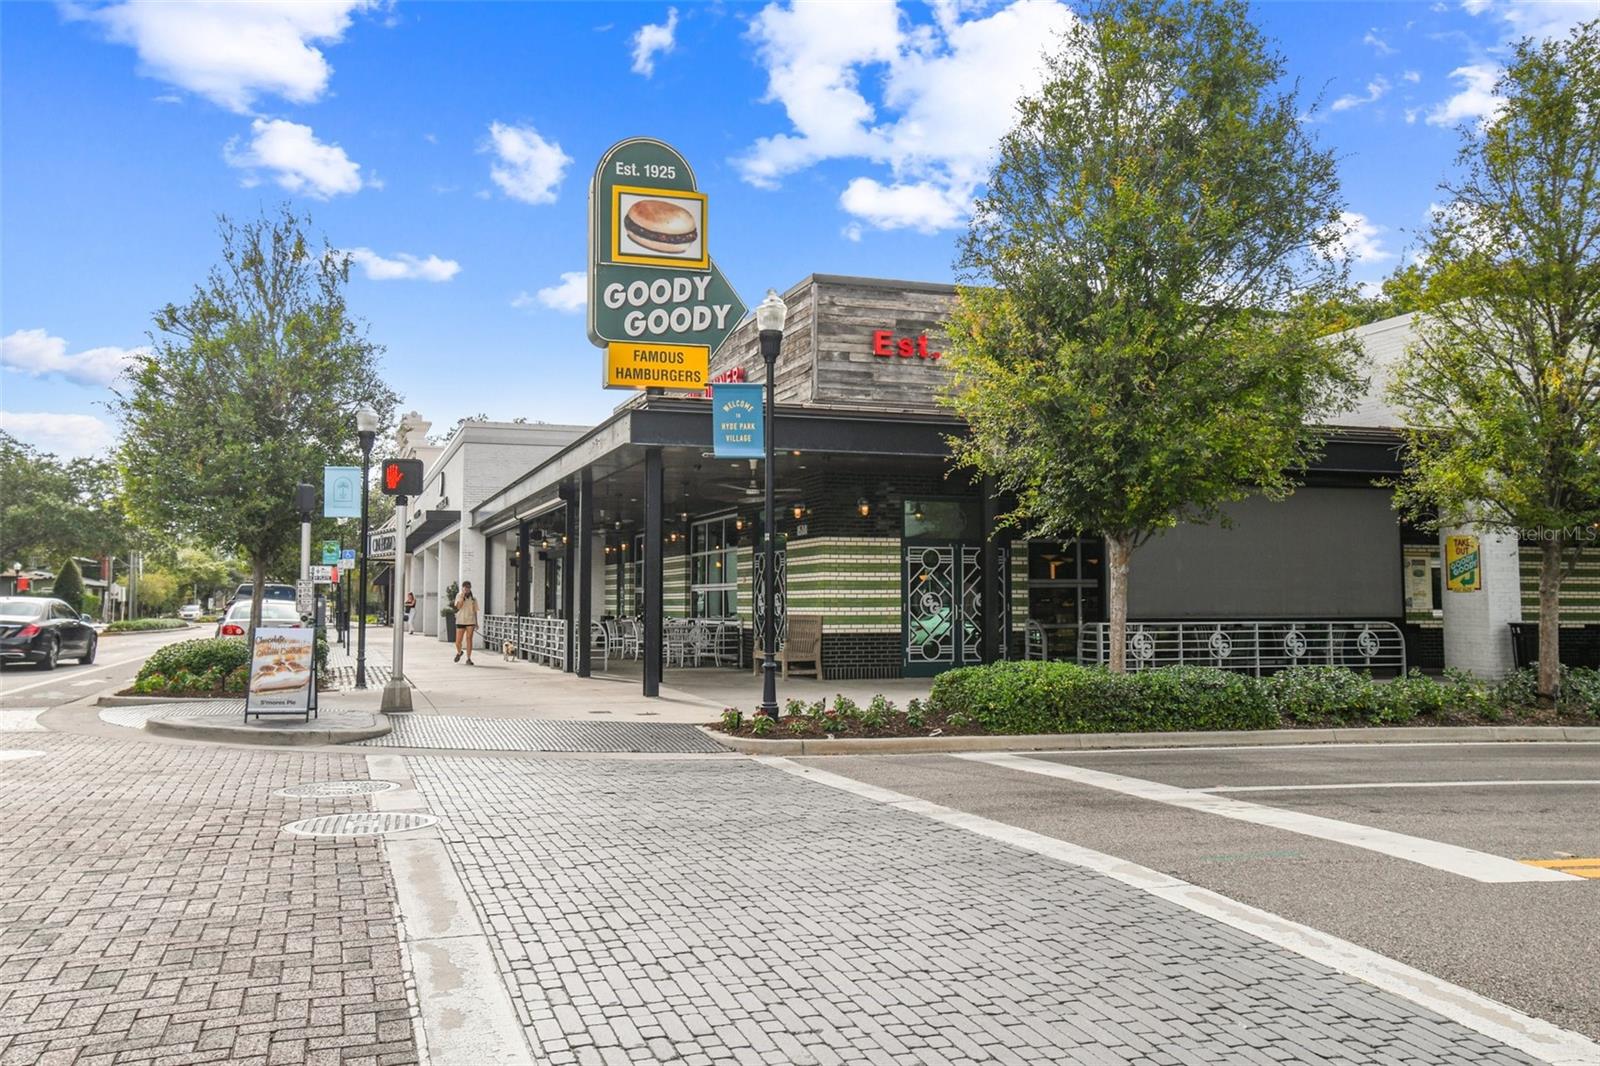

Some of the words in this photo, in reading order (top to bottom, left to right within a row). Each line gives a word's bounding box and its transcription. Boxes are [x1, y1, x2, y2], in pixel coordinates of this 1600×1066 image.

[615, 161, 640, 177] Est.
[643, 164, 676, 180] 1925
[603, 275, 713, 310] GOODY
[624, 304, 732, 337] GOODY
[872, 329, 943, 360] Est.
[633, 350, 684, 364] FAMOUS
[615, 367, 701, 383] HAMBURGERS
[722, 400, 754, 412] WELCOME
[721, 422, 737, 430] HYDE
[739, 422, 756, 430] PARK
[725, 434, 752, 442] VILLAGE
[1455, 547, 1469, 555] OUT
